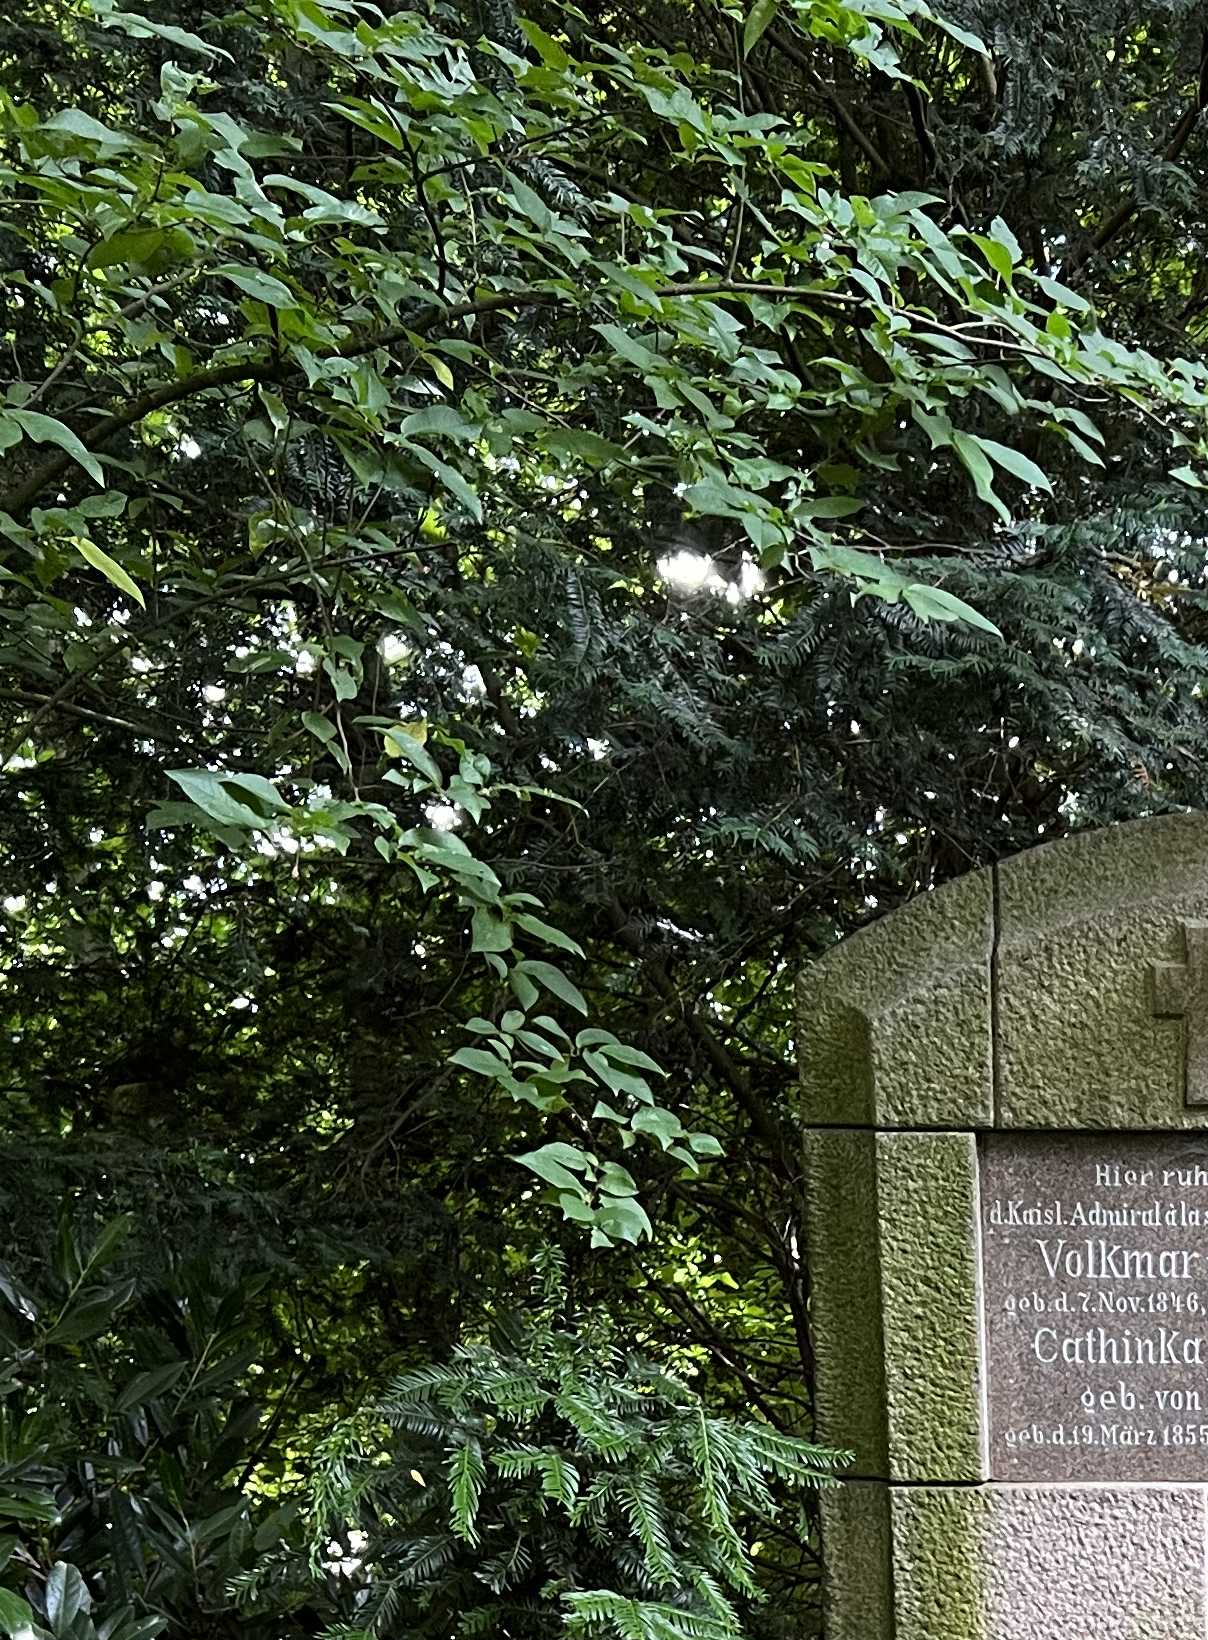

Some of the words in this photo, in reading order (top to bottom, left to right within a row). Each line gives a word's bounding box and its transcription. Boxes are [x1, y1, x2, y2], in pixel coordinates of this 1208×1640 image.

[1096, 1164, 1153, 1187] Hier
[1069, 1200, 1161, 1227] Admiral
[1181, 1200, 1200, 1227] la
[1035, 1238, 1200, 1279] Volkmar
[1033, 1327, 1204, 1364] Cathinka
[1079, 1380, 1145, 1413] geb.
[1154, 1389, 1202, 1411] von
